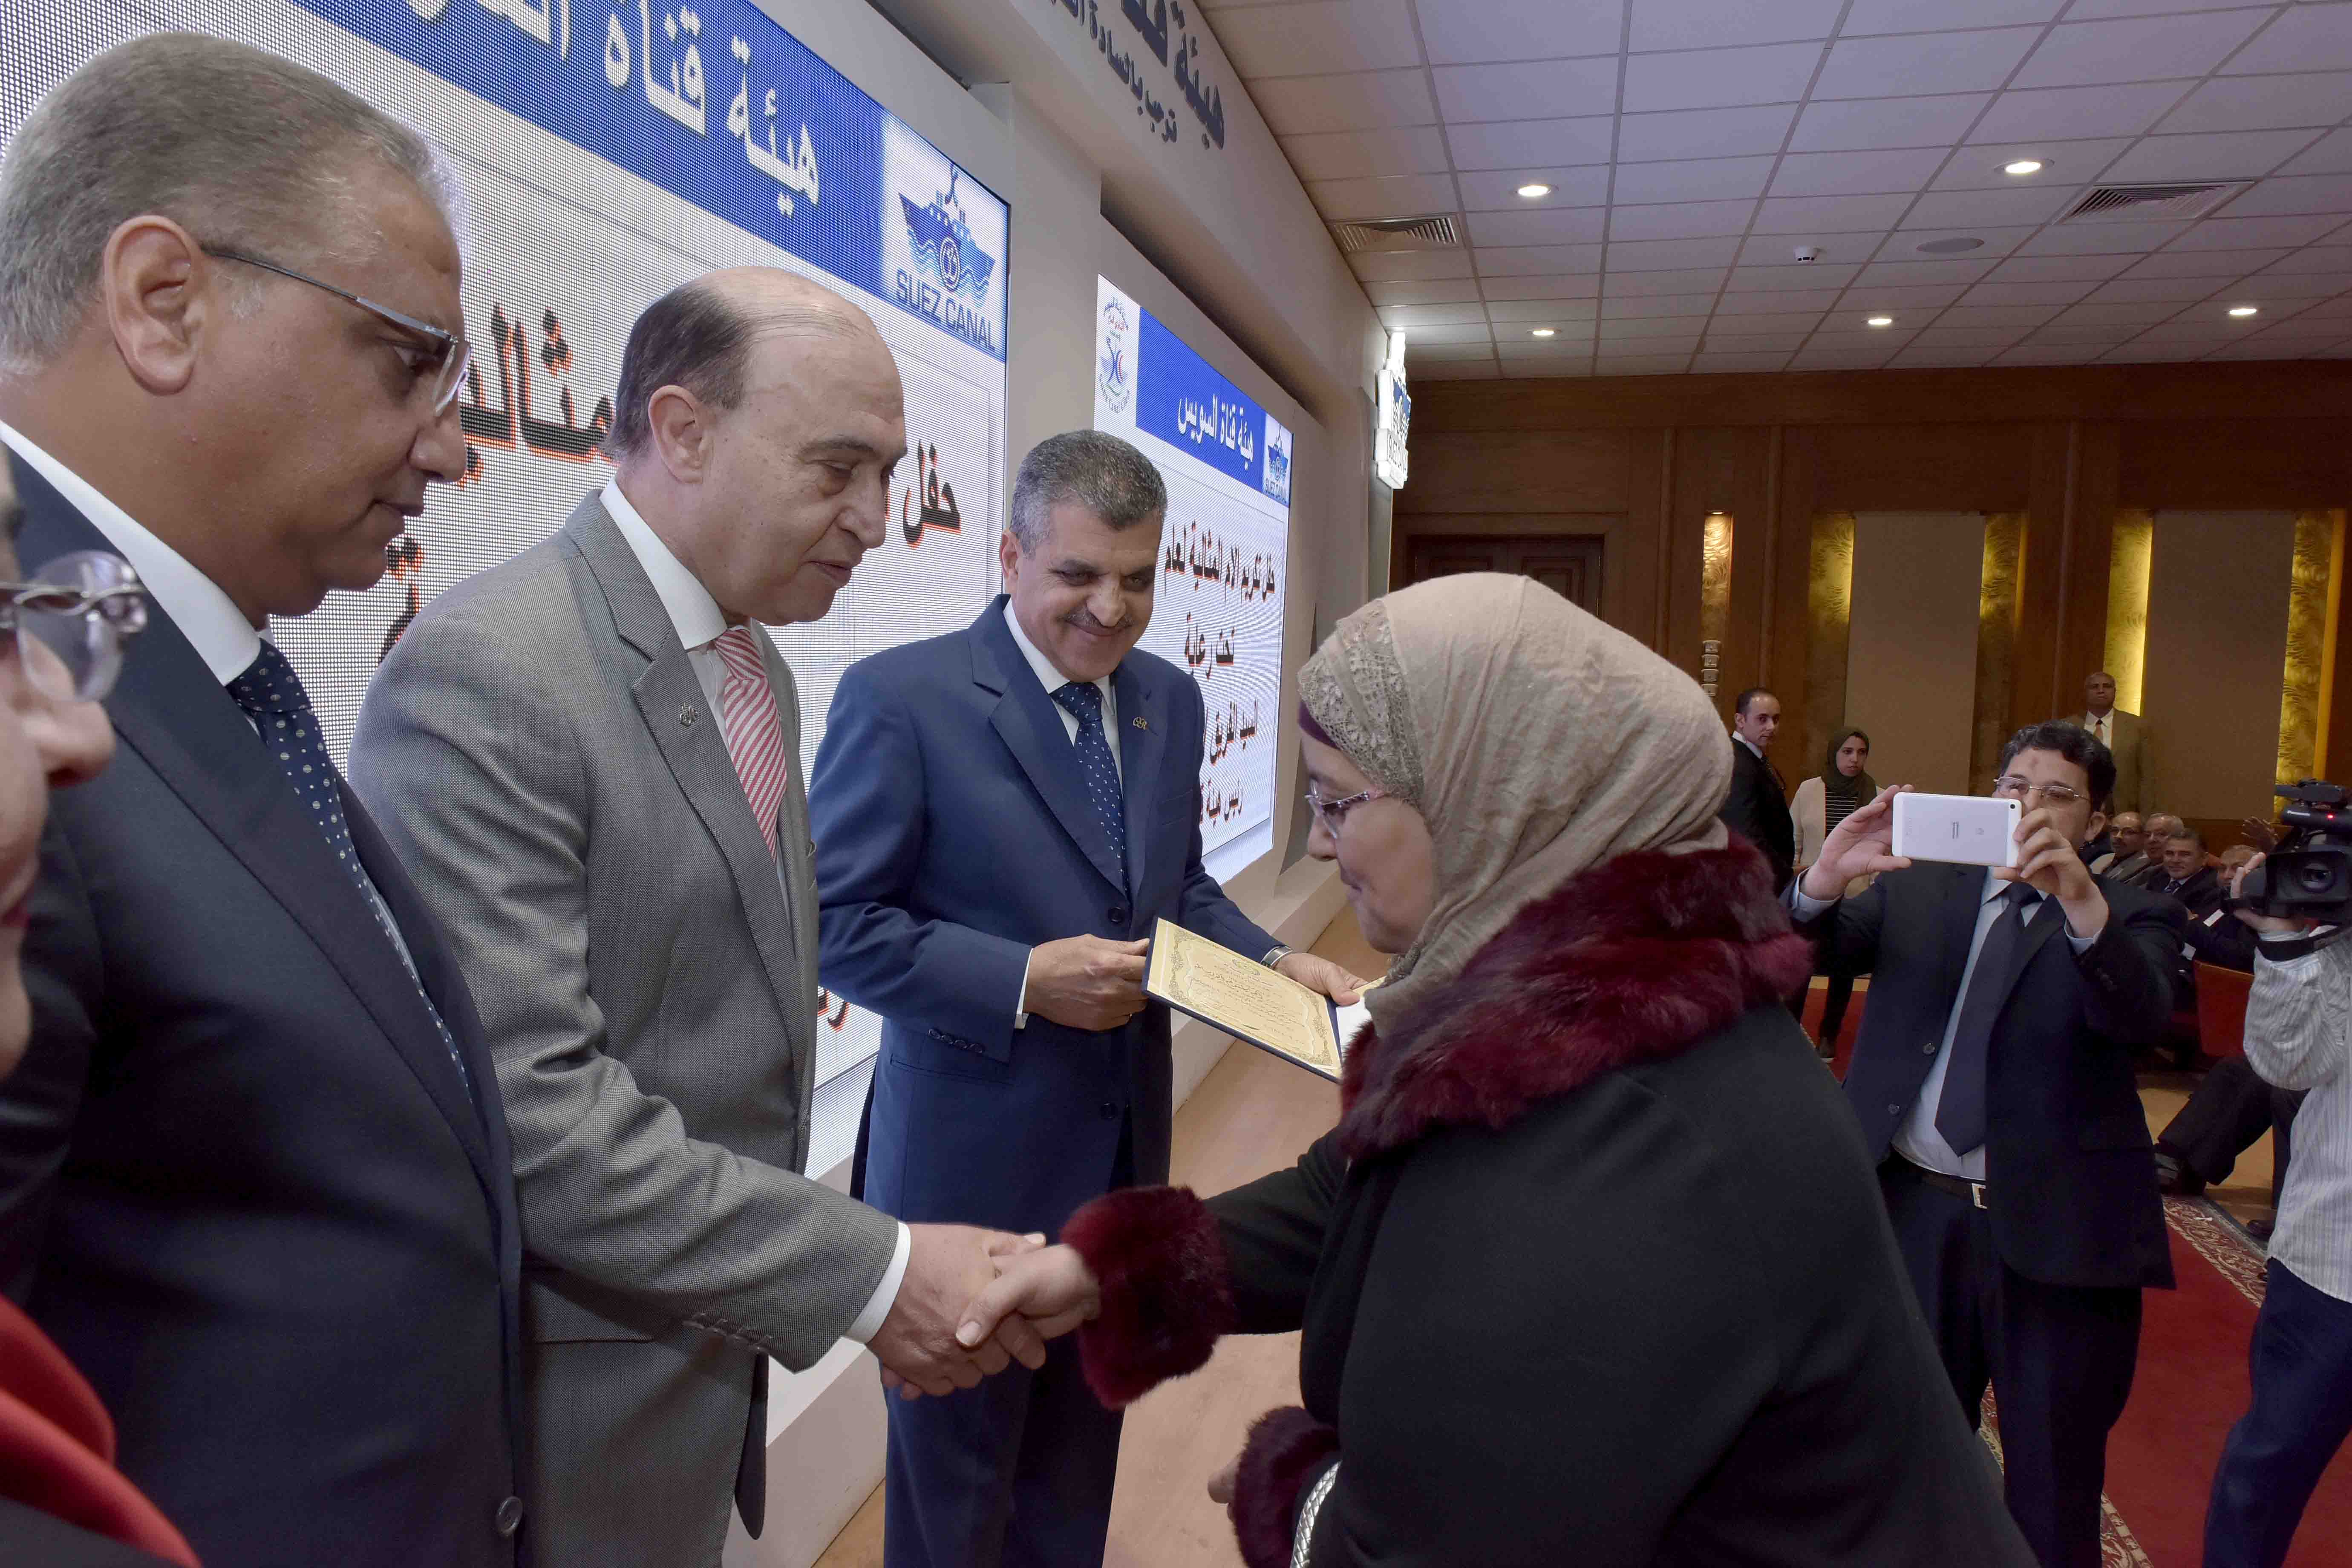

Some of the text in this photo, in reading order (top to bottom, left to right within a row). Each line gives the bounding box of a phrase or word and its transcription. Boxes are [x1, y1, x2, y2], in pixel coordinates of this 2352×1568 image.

[726, 35, 820, 216] هيئة
[896, 268, 995, 352] SUEZ CANAL
[1178, 393, 1217, 444] السويس
[1220, 402, 1236, 450] قناة
[1237, 406, 1254, 471] هيئة
[903, 439, 961, 550] حفل
[1164, 523, 1186, 596] لعام
[1189, 519, 1223, 593] المثالية
[1240, 553, 1261, 608] تكريم
[1262, 552, 1275, 602] حفل
[1184, 611, 1234, 681] تحت رعاية
[1210, 700, 1237, 767] الفريق
[1240, 698, 1258, 752] السيد
[1206, 777, 1221, 829] هيئة
